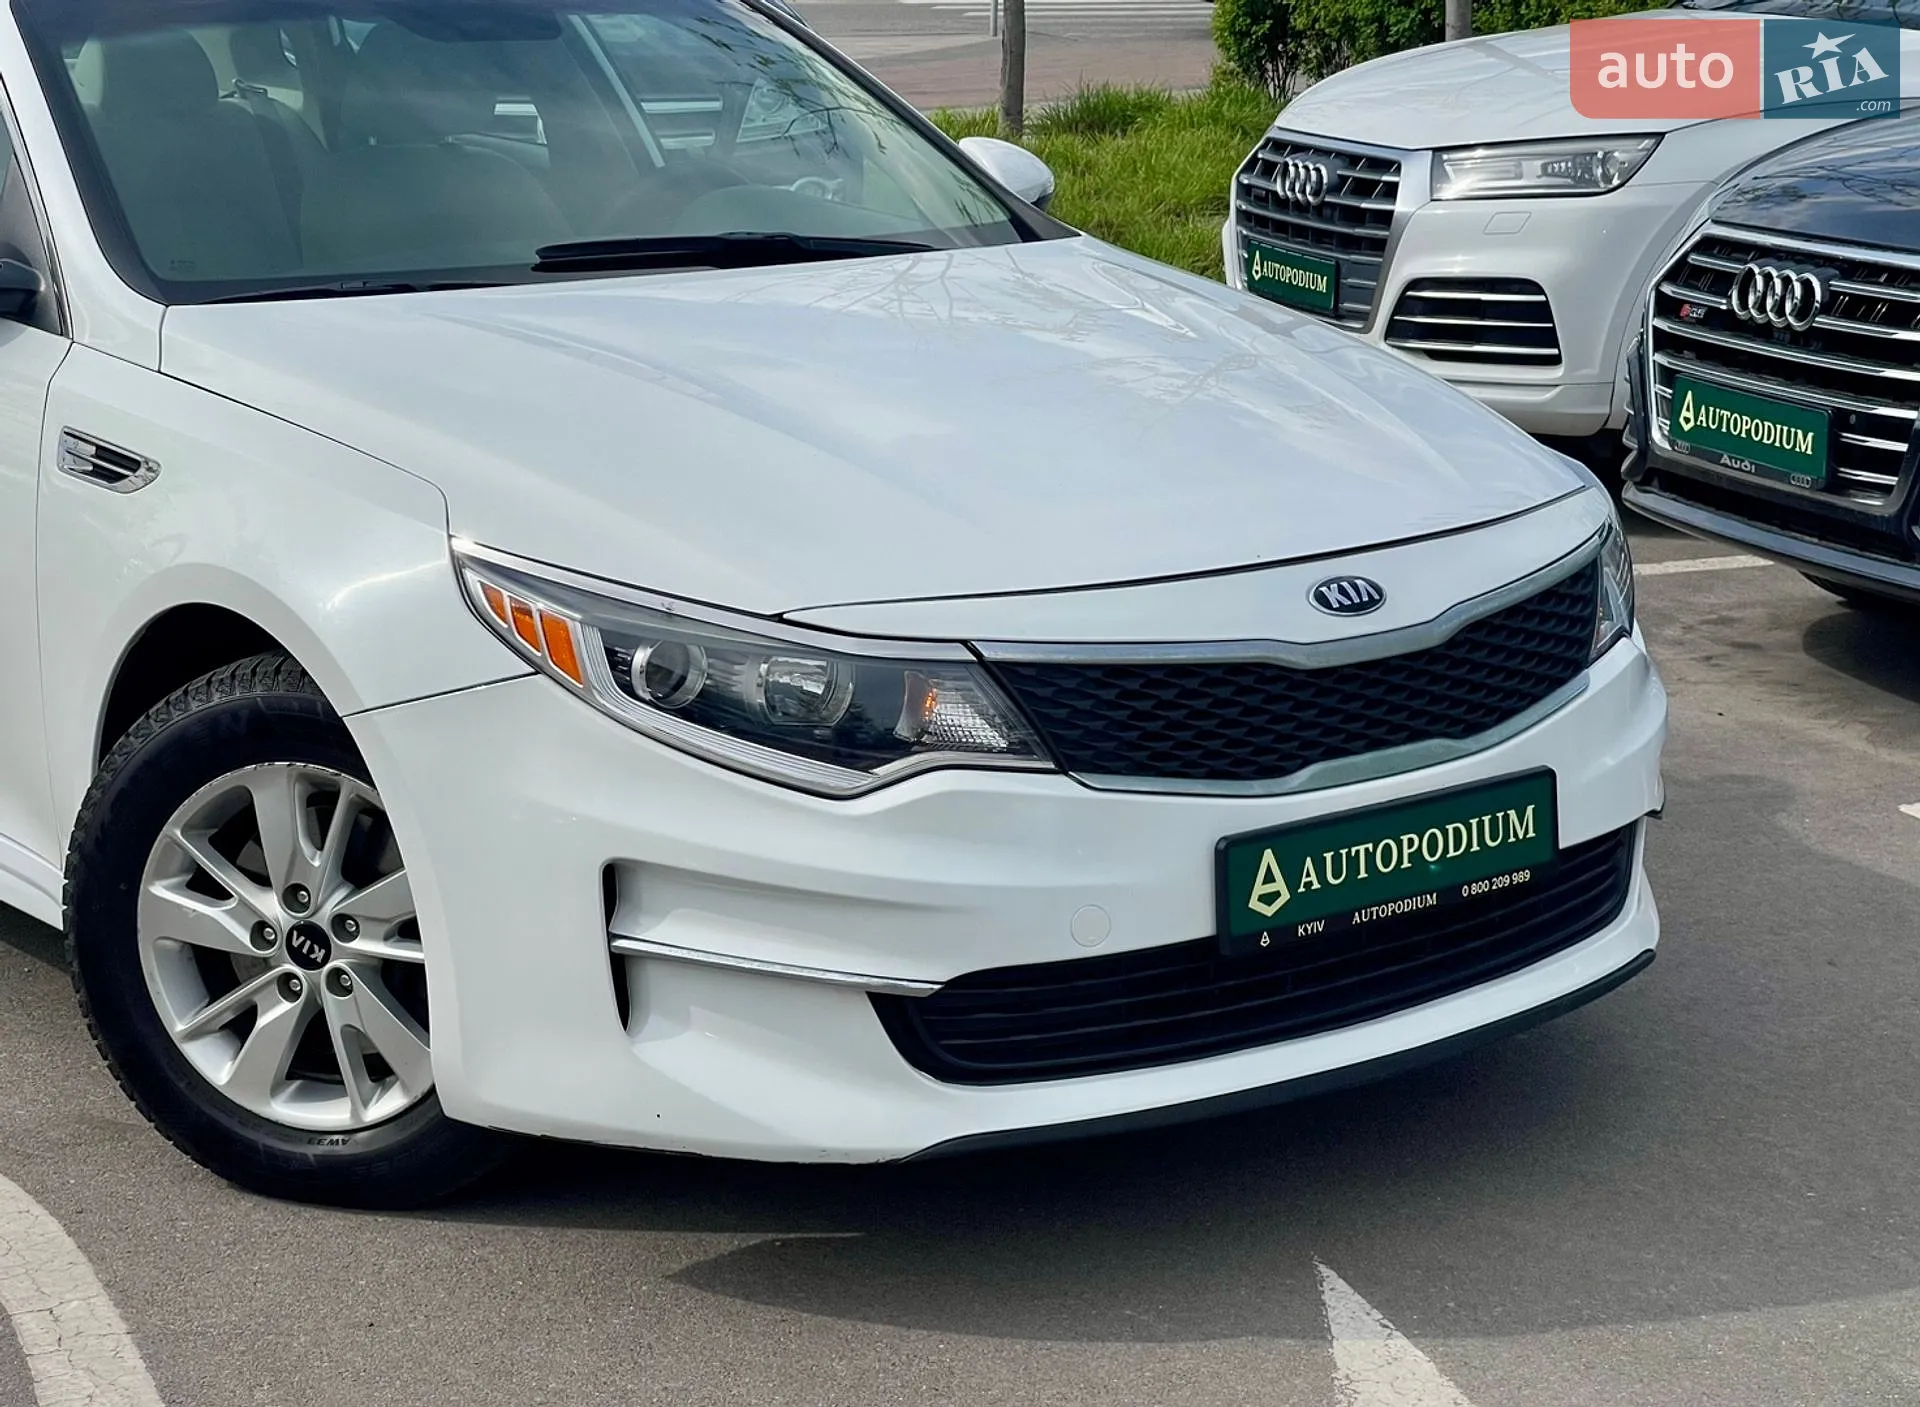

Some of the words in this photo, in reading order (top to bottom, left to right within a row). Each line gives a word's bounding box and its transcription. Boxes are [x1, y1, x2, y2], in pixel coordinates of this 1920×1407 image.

[1262, 260, 1328, 293] AUTOPODIUM
[1696, 404, 1815, 455] AUTOPODIUM
[1720, 453, 1756, 474] Audi
[1319, 579, 1380, 608] KIA
[1297, 804, 1536, 893] AUTOPODIUM
[1462, 885, 1469, 897] 0
[1471, 880, 1489, 894] 800
[1492, 874, 1510, 889] 209
[1512, 869, 1530, 884] 989
[1352, 893, 1437, 924] AUTOPODIUM
[1298, 920, 1325, 937] KYIV
[292, 930, 325, 962] KIA
